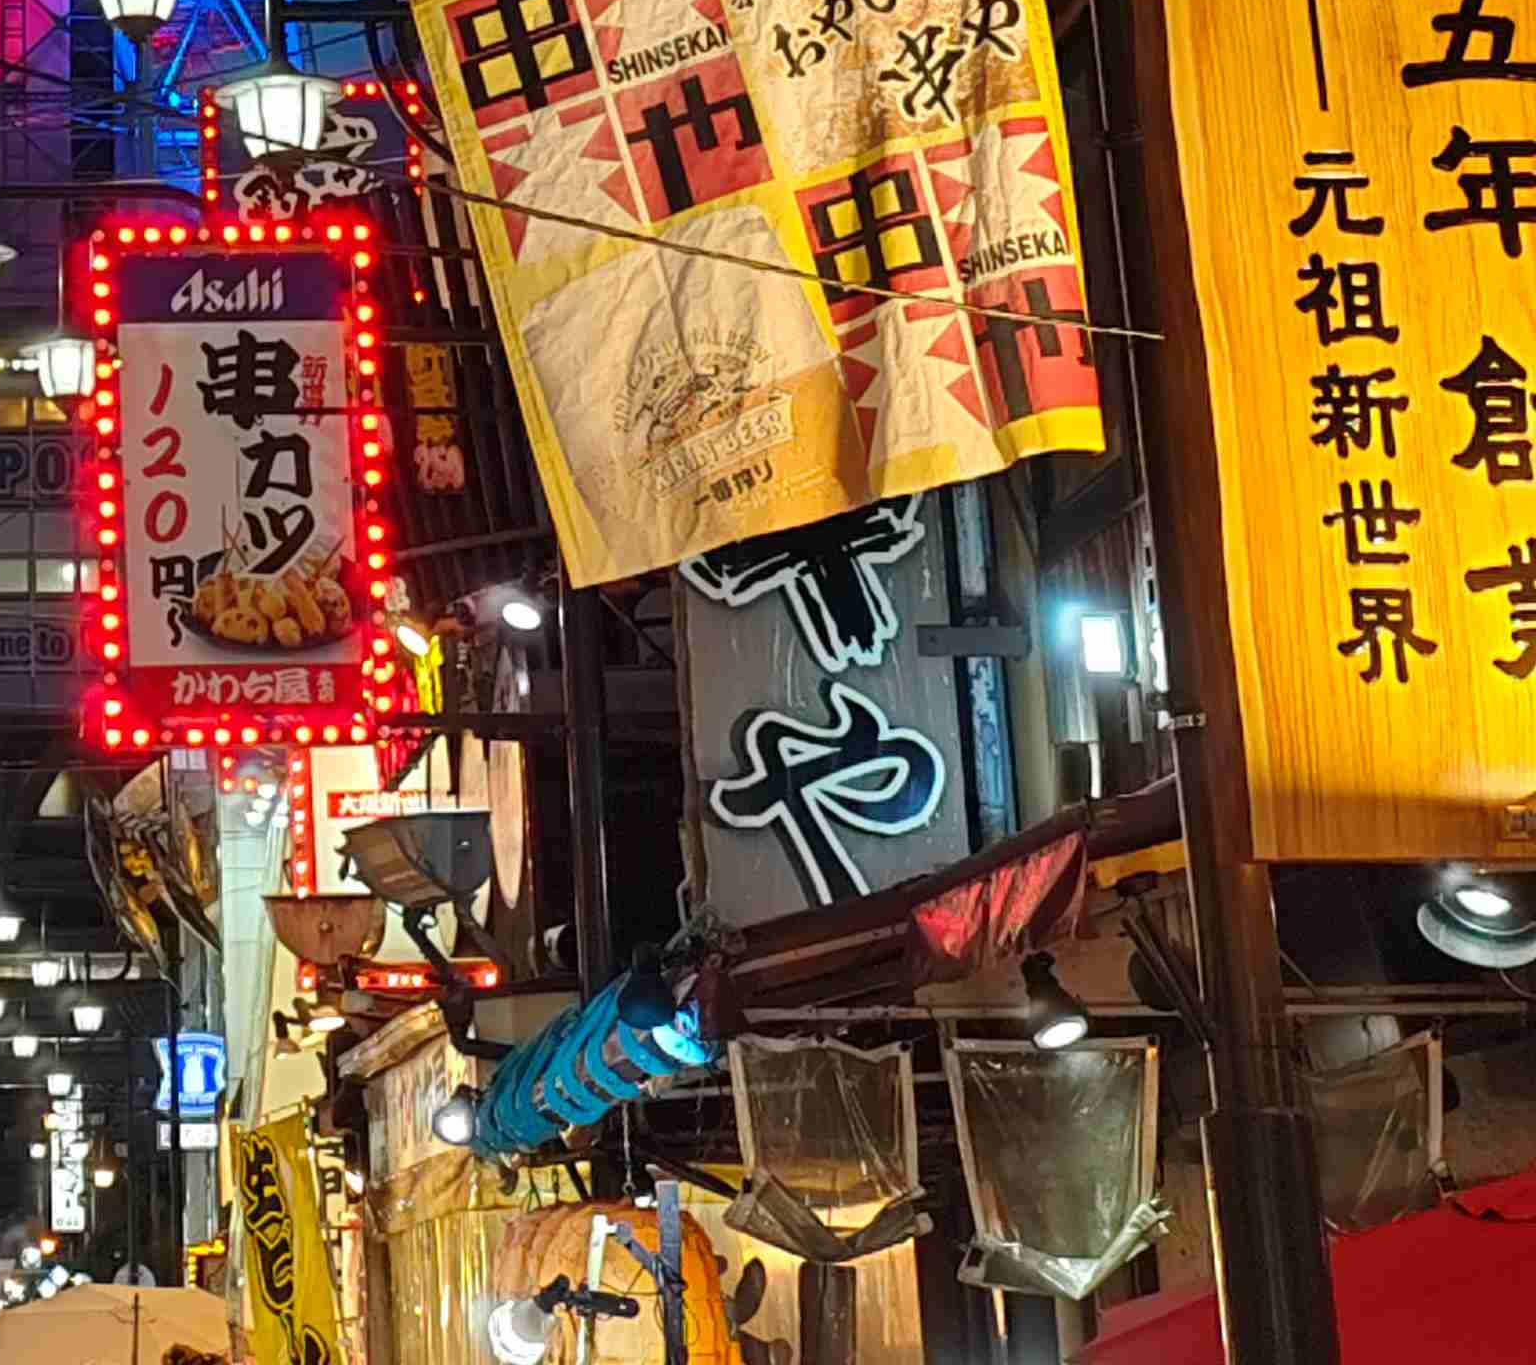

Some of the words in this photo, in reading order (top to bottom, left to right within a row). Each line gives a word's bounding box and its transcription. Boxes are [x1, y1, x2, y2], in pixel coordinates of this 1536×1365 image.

[608, 23, 728, 85] SHINSEKAI
[170, 267, 286, 315] Asahi
[196, 329, 316, 573] 串カツ
[1289, 151, 1438, 684] 元祖新世界
